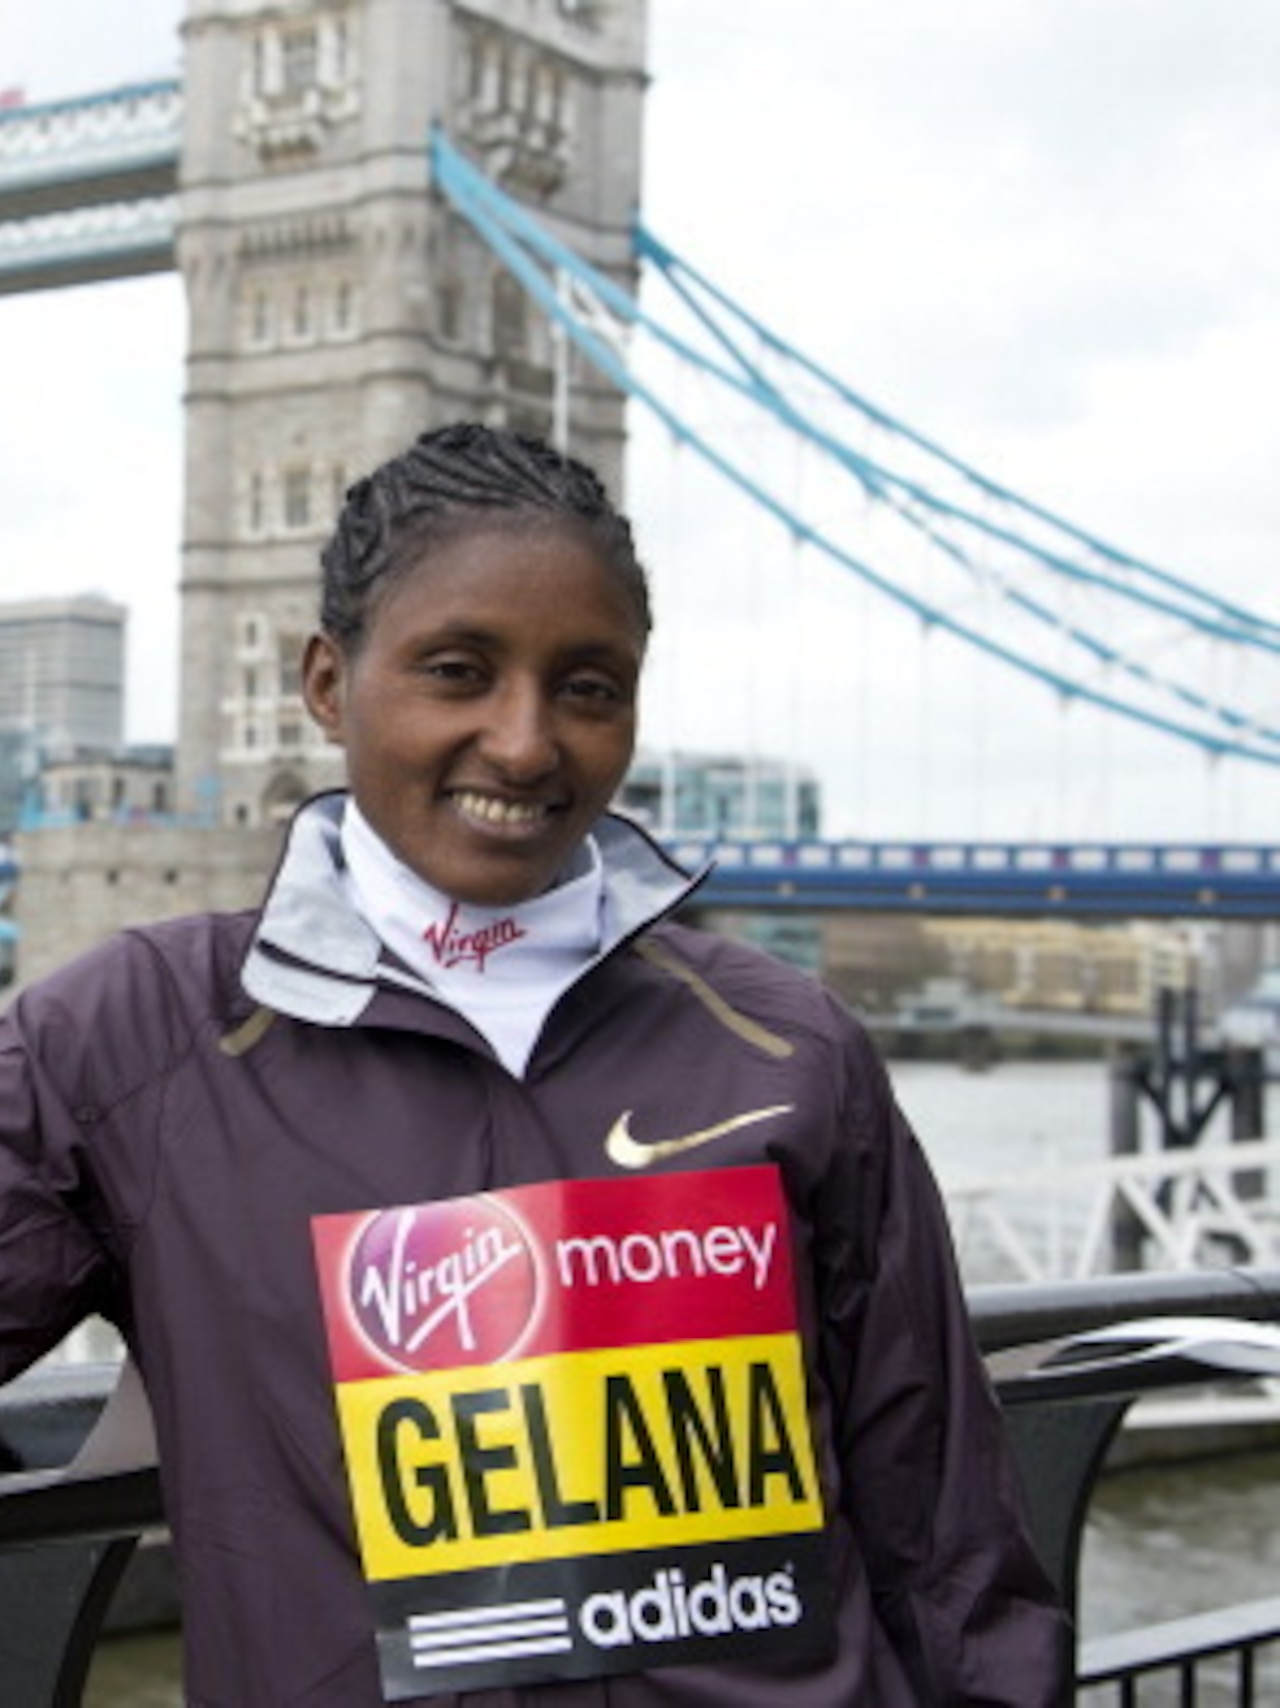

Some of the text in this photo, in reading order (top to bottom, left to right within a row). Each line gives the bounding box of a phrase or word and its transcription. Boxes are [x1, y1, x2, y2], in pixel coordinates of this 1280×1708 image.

[422, 902, 527, 974] Virgin
[360, 1208, 777, 1351] Virgin money
[375, 1362, 805, 1547] GELANA
[578, 1563, 802, 1647] adidas
